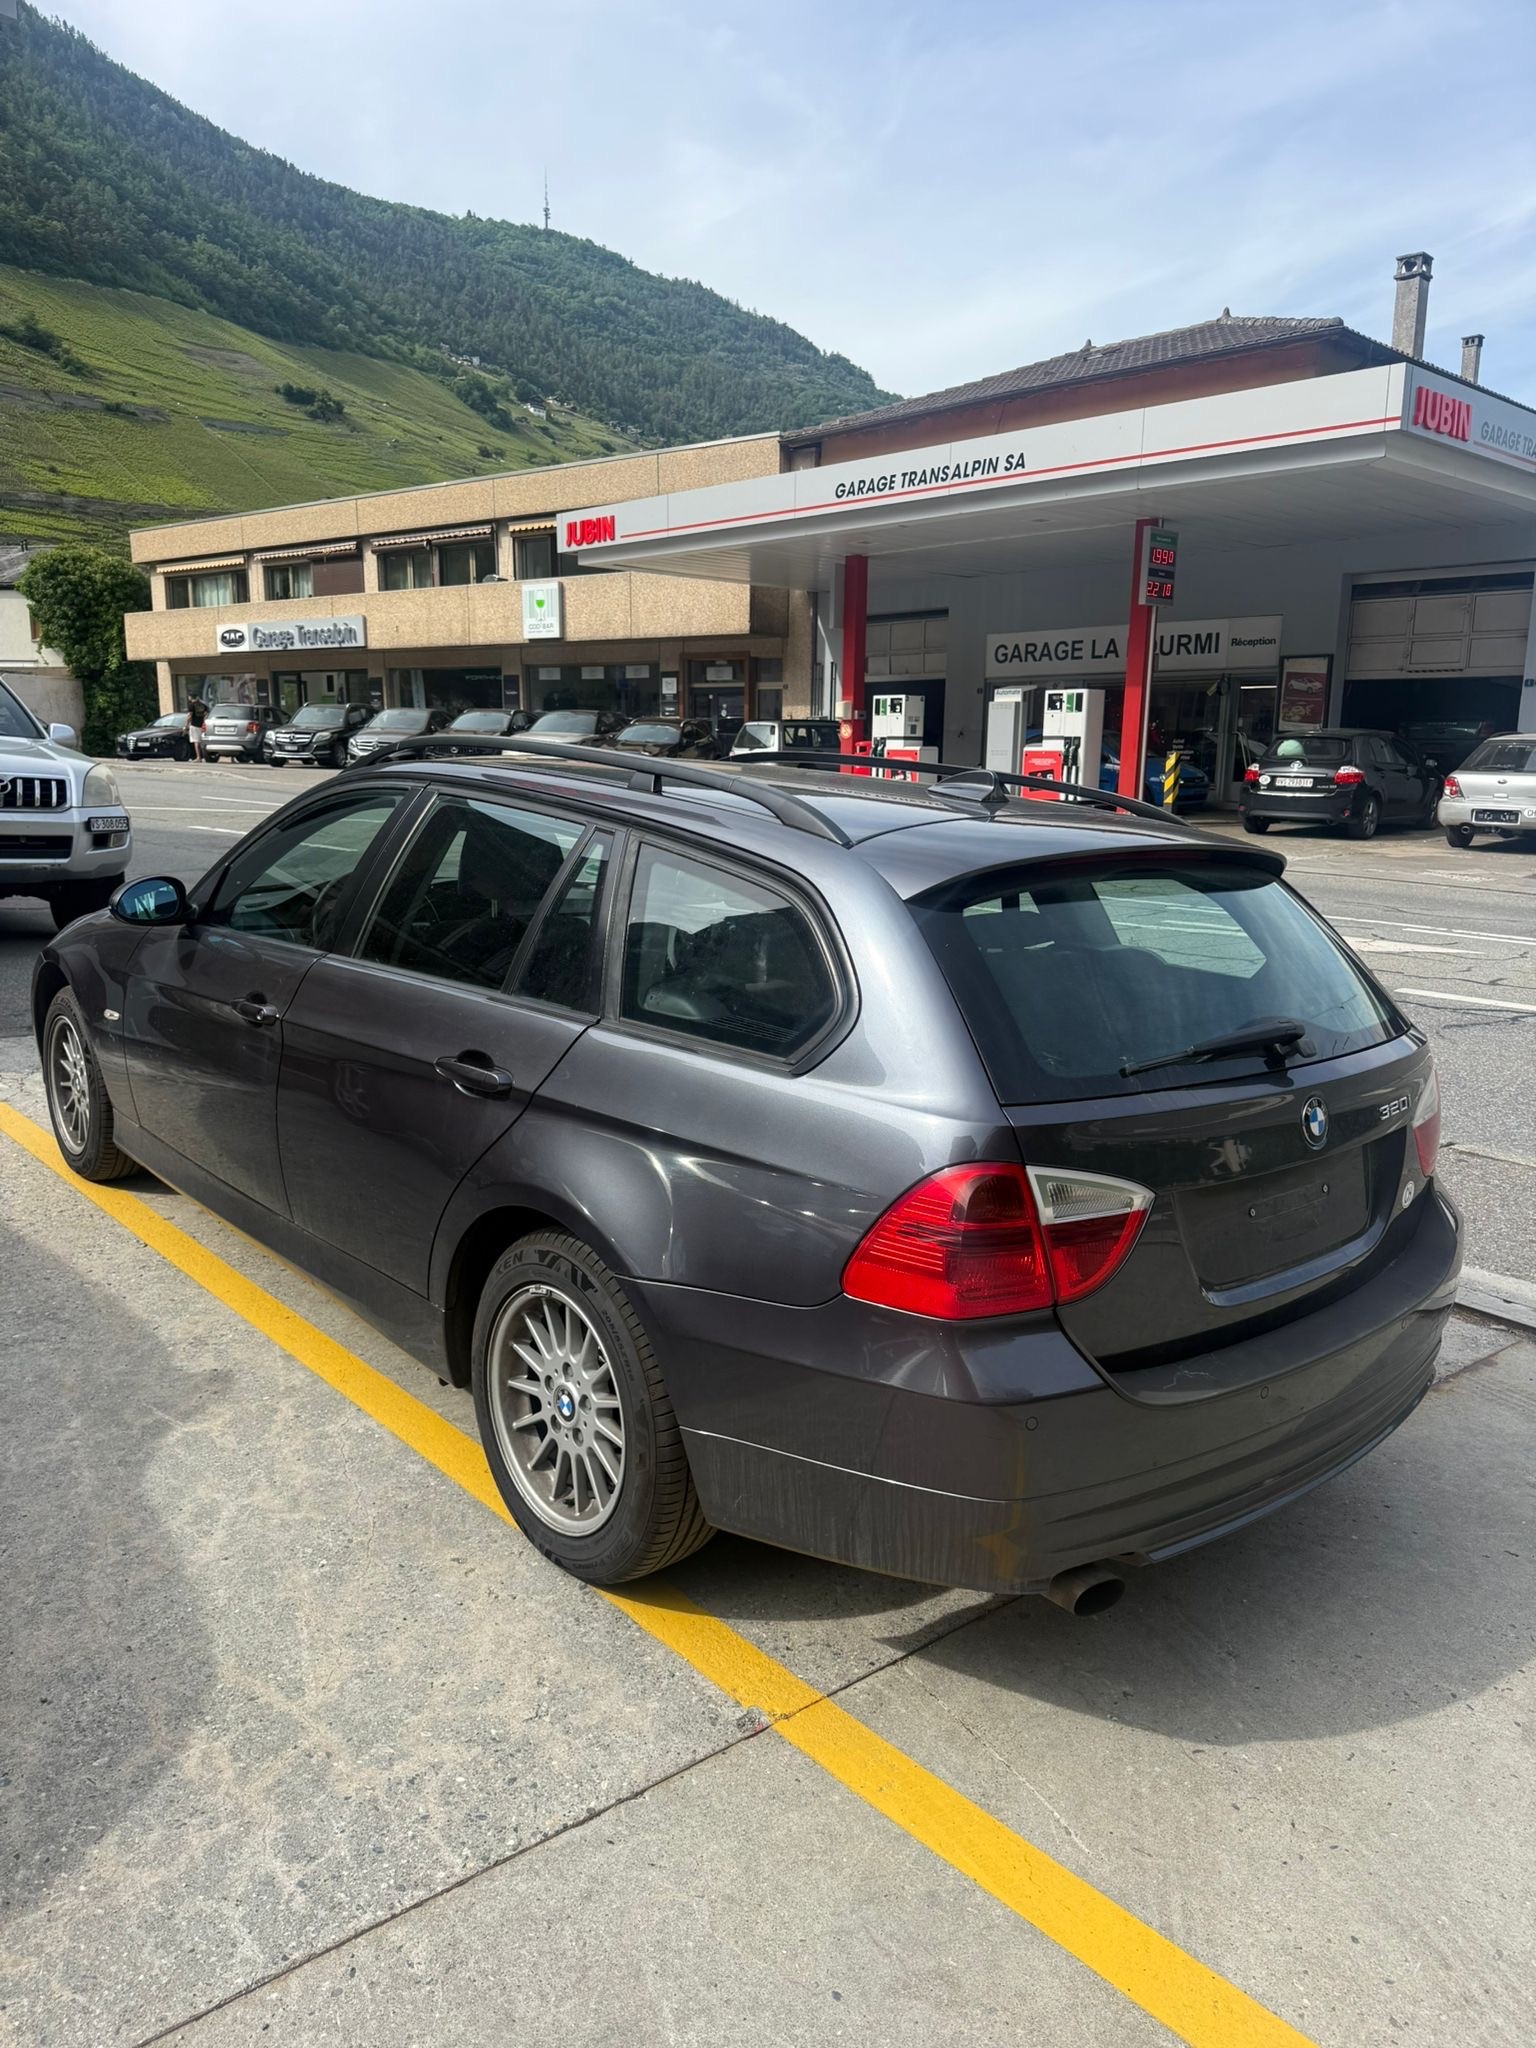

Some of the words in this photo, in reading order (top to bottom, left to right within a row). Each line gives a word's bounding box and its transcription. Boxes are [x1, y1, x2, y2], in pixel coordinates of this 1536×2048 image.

[1414, 386, 1472, 442] JUBIN
[1481, 421, 1521, 451] GARAGE
[835, 474, 896, 499] GARAGE
[900, 456, 999, 489] TRANSALPIN
[1004, 452, 1026, 472] SA
[566, 514, 616, 548] JUBIN
[253, 626, 295, 650] Garage
[295, 622, 358, 647] Transalpin
[994, 640, 1084, 665] GARAGE
[1091, 637, 1120, 660] LA
[1153, 631, 1220, 656] URMI
[1231, 637, 1277, 648] Réception
